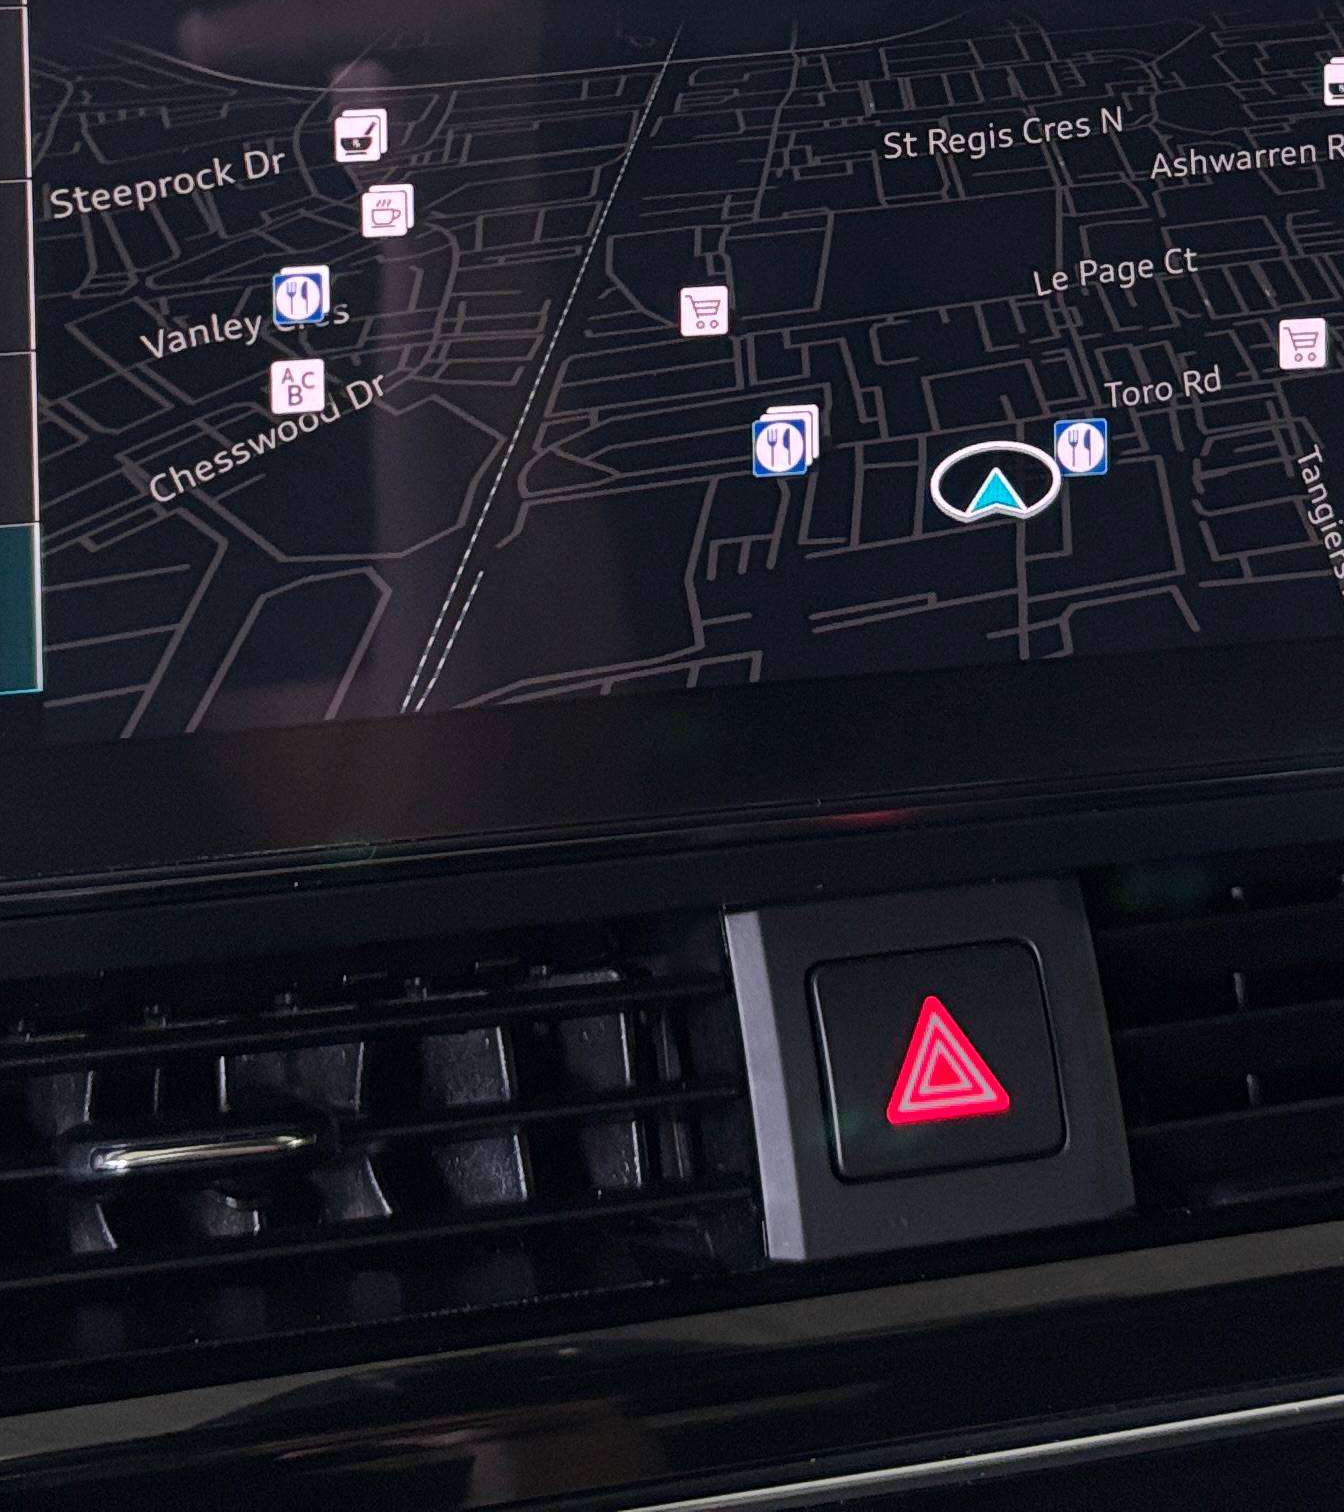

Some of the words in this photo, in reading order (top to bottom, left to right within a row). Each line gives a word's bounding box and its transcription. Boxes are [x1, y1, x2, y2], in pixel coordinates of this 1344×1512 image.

[883, 132, 918, 159] St
[928, 122, 1014, 159] Regis
[1023, 117, 1091, 144] Cres
[1100, 105, 1124, 134] N
[50, 157, 236, 219] Steeprock
[244, 149, 286, 179] Dr
[1150, 143, 1317, 179] Ashwarren
[1033, 271, 1069, 297] Le
[1080, 258, 1155, 289] Page
[1163, 247, 1199, 275] Ct
[139, 312, 262, 359] Vanley
[1104, 380, 1174, 408] Toro
[1182, 364, 1222, 397] Rd
[149, 392, 342, 503] Chesswood
[346, 374, 385, 410] Dr
